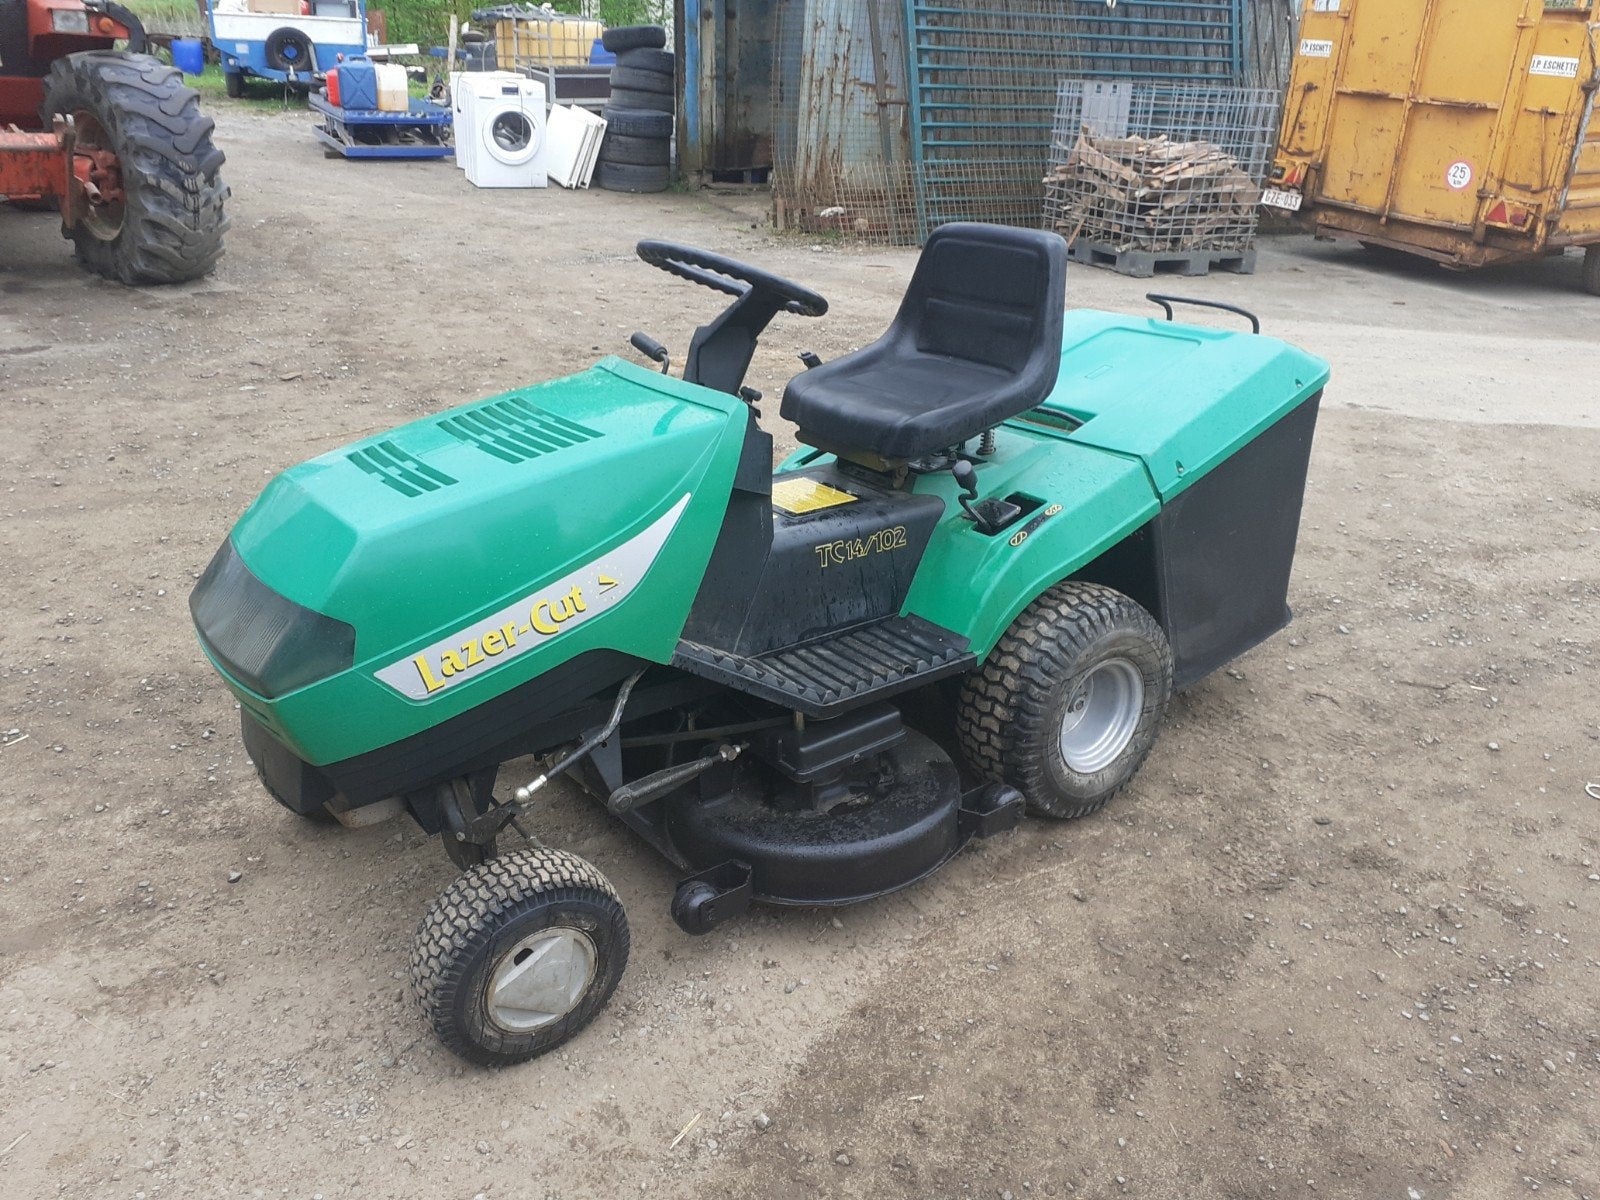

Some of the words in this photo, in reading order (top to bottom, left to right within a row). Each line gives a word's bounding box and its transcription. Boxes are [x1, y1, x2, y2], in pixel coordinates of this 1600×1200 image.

[1543, 60, 1578, 71] ESCHETTE
[1452, 165, 1467, 179] 25
[413, 584, 588, 694] Lazer-Cut
